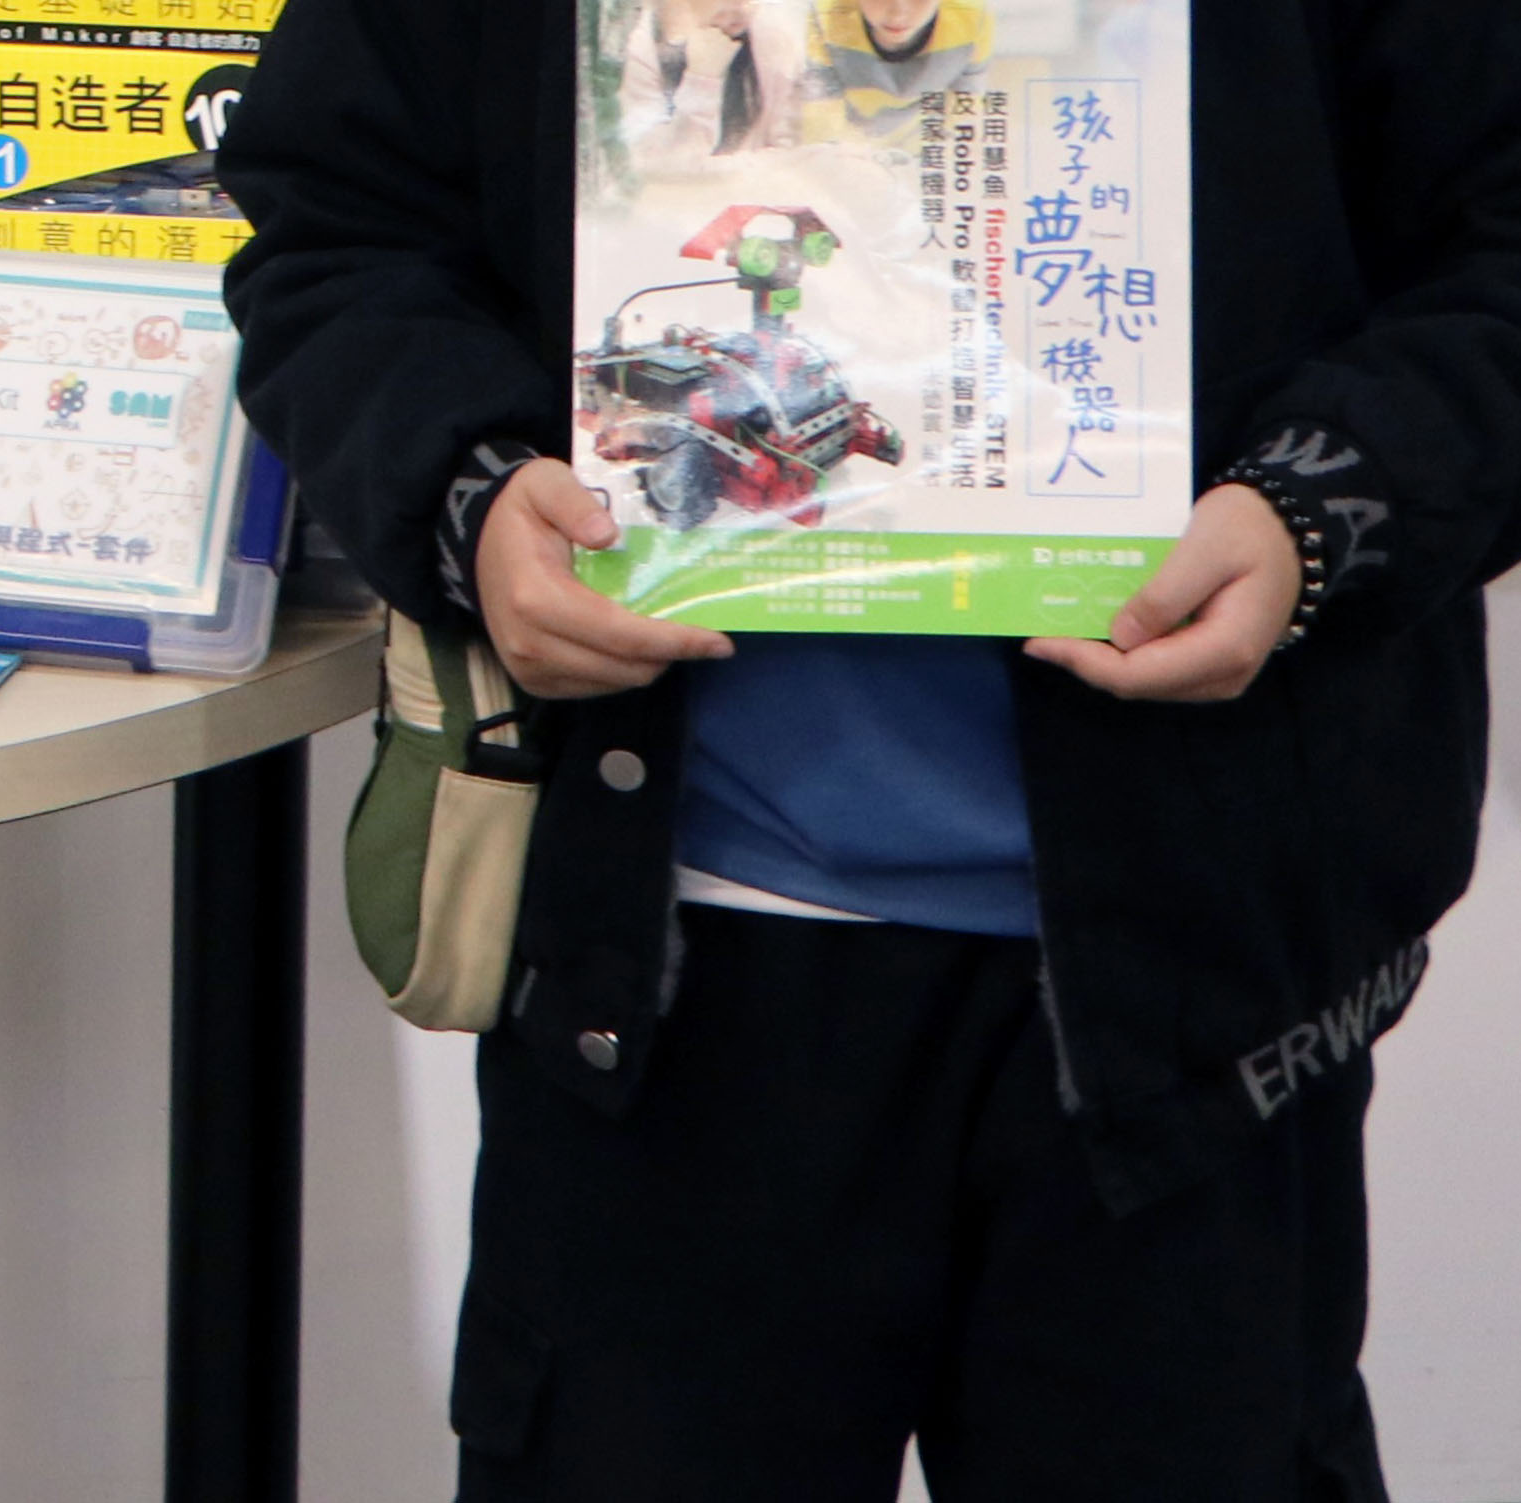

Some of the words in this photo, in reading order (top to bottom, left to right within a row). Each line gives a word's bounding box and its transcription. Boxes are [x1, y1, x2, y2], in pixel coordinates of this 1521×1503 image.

[0, 23, 27, 41] of
[41, 26, 122, 45] Maker
[953, 124, 976, 193] Robo
[953, 204, 977, 251] Pro
[984, 412, 1007, 489] STEM
